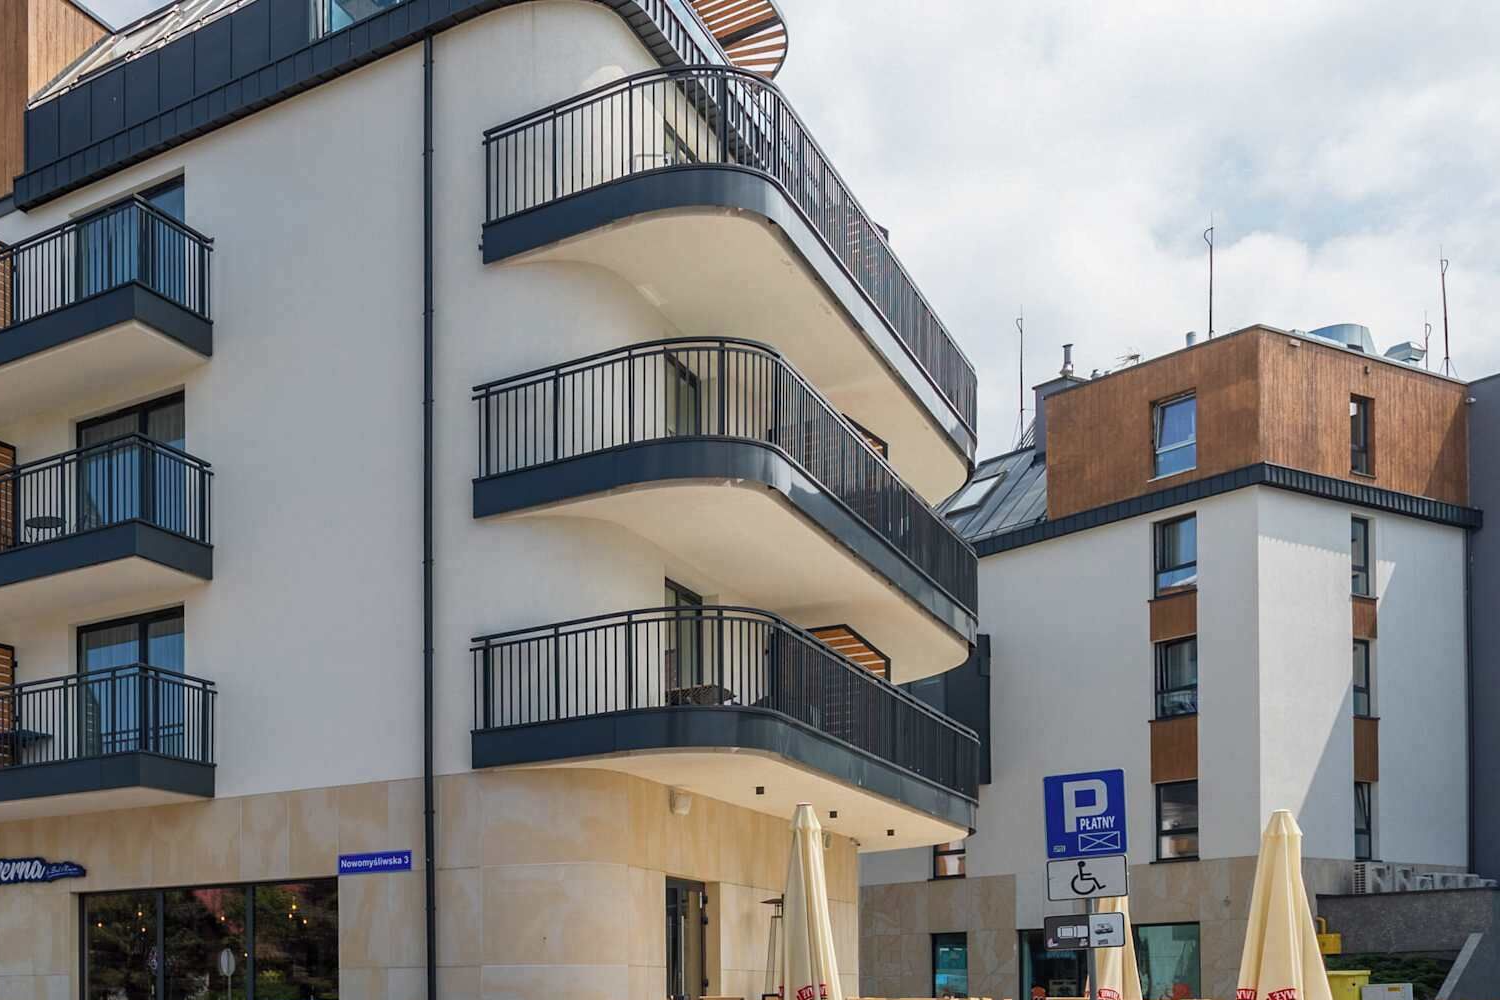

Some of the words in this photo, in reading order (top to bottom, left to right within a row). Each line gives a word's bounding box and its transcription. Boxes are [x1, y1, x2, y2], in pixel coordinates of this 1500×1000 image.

[1063, 779, 1108, 833] P
[1080, 816, 1115, 831] PŁATNY
[404, 855, 409, 864] 3
